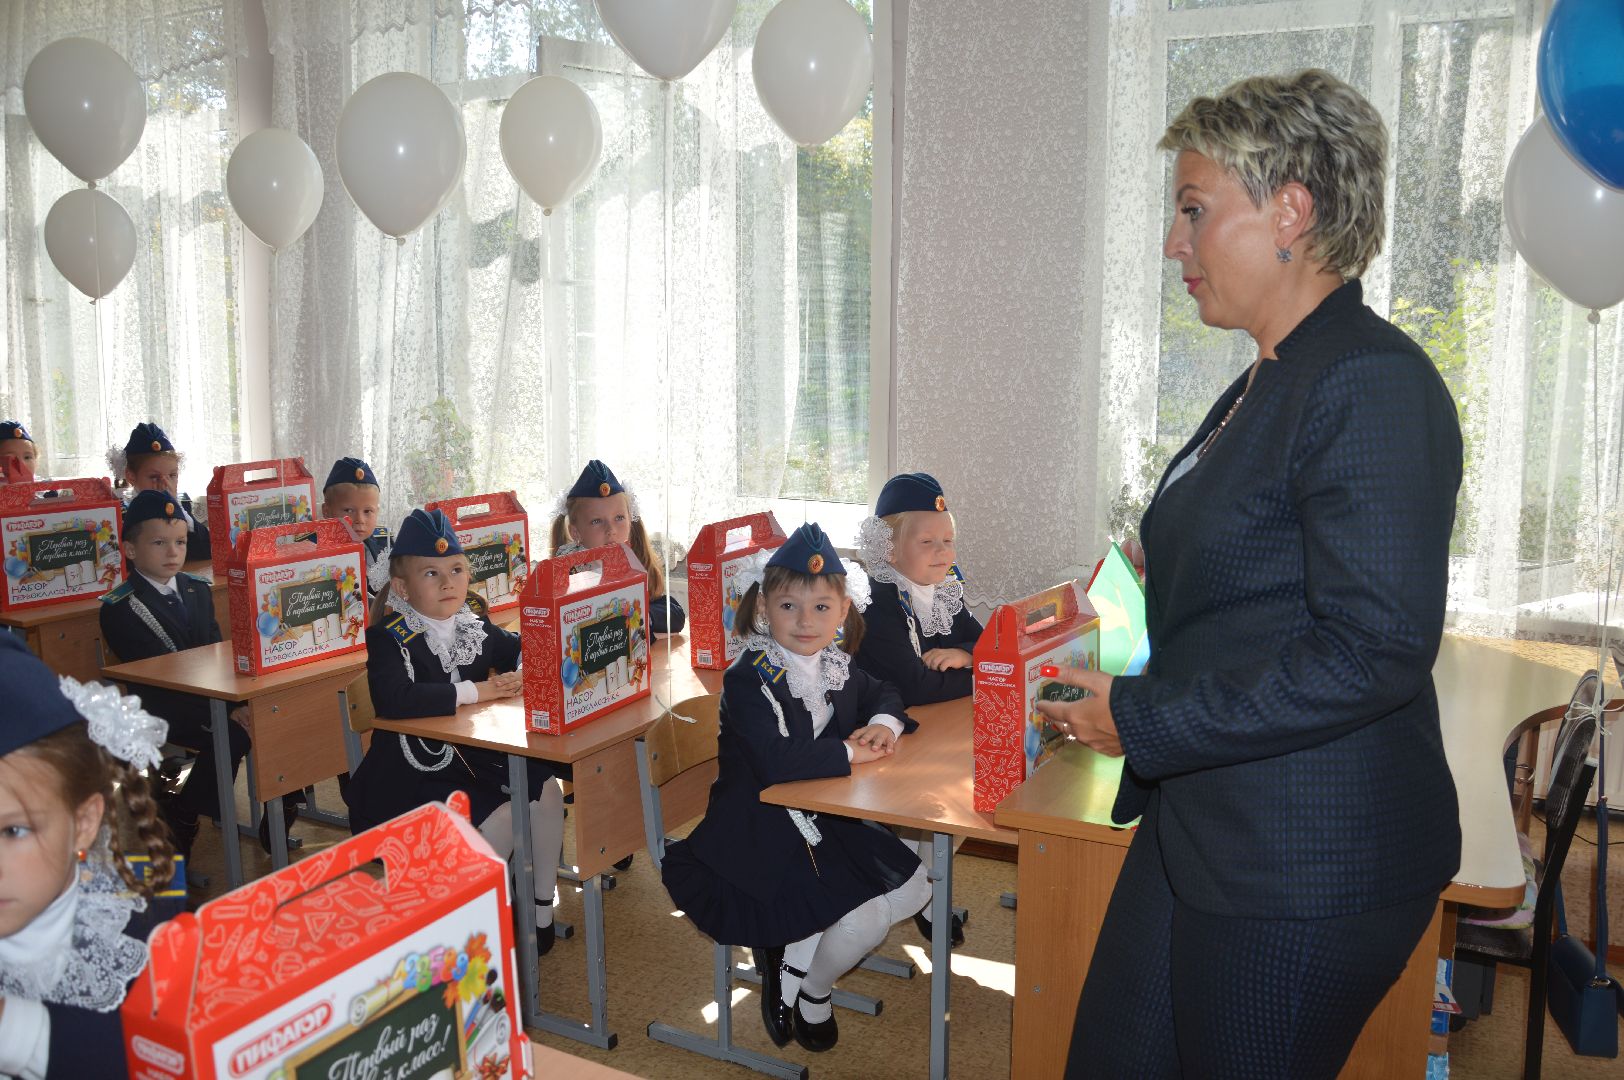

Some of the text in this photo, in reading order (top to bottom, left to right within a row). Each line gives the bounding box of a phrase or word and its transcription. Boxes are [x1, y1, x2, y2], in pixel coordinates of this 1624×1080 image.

[38, 537, 87, 552] Первый раз
[36, 549, 42, 561] в
[43, 548, 67, 562] первый
[11, 582, 48, 594] НАБОР
[288, 587, 334, 605] Первый раз
[286, 597, 339, 618] в первый класс!
[587, 625, 624, 647] Первый раз
[265, 641, 297, 655] НАБОР
[584, 649, 590, 662] в
[590, 645, 608, 662] первый
[566, 691, 593, 709] НАБОР
[235, 1002, 329, 1073] ПИФАГОР
[328, 1013, 440, 1080] Первый раз
[396, 1024, 452, 1080] класс!
